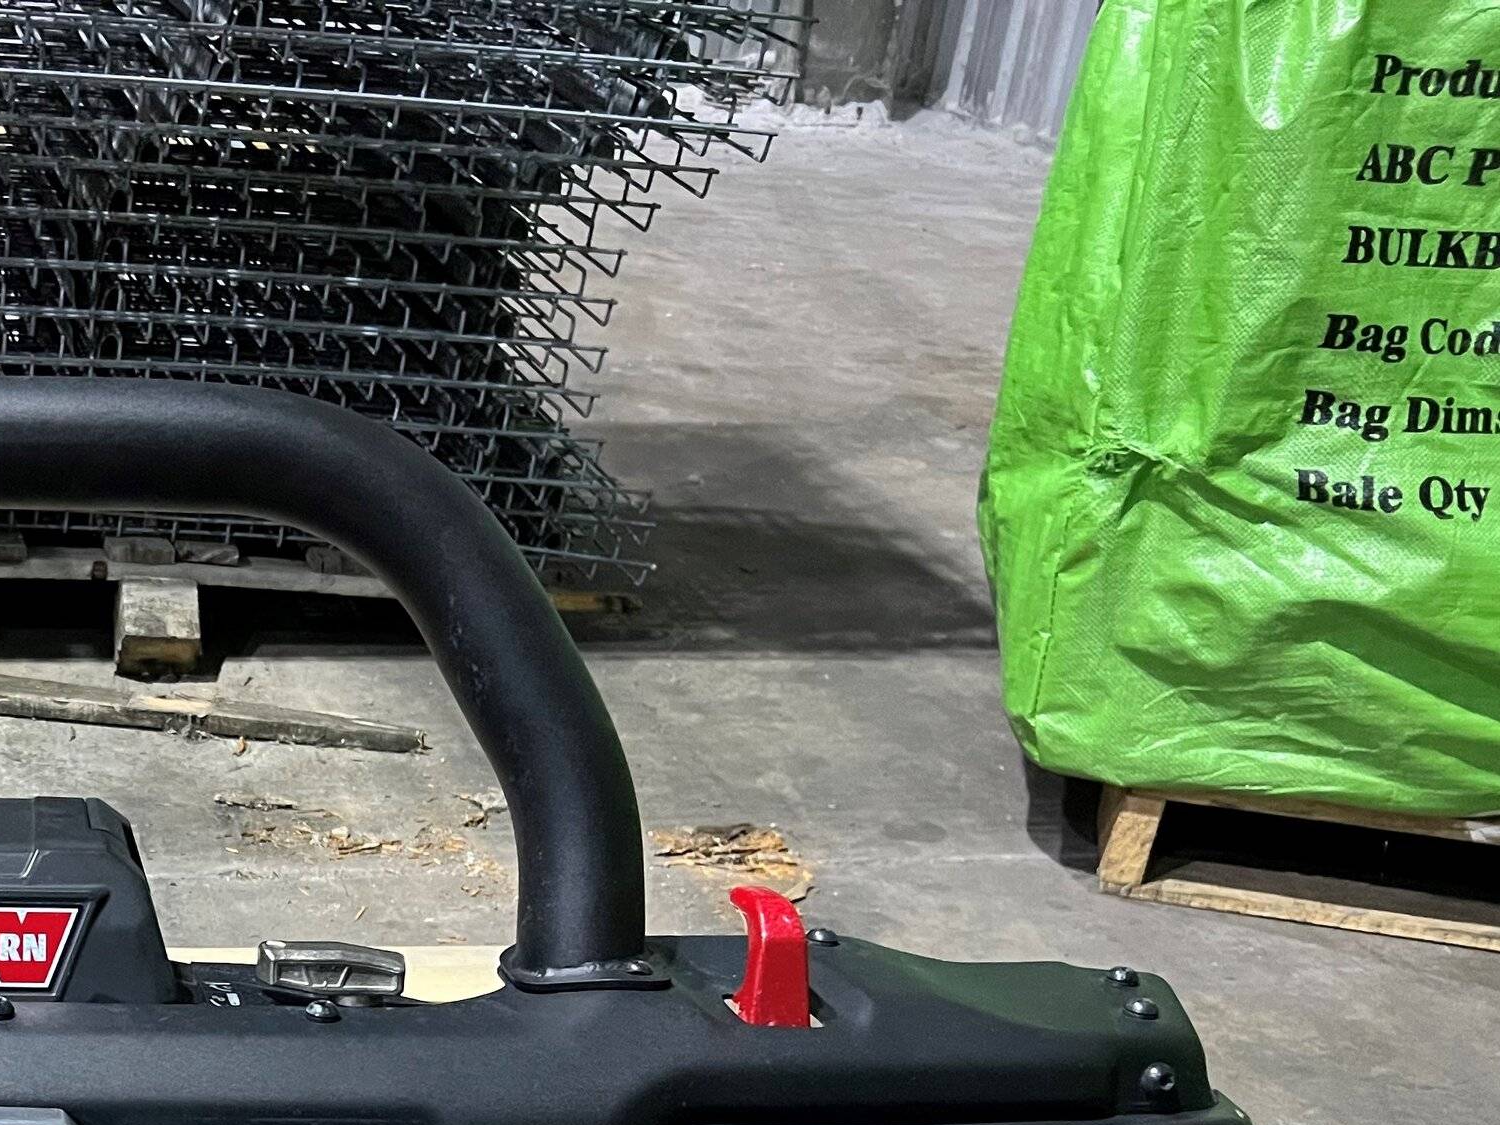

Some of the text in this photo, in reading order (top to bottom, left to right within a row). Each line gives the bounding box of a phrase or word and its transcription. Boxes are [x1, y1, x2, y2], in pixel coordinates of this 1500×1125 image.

[1370, 54, 1500, 99] Produ
[1355, 143, 1456, 185] ABC
[1341, 225, 1500, 270] BULKB
[1317, 313, 1500, 363] Bag Cod
[1297, 389, 1392, 442] Bag
[1295, 468, 1491, 522] Bale Qty
